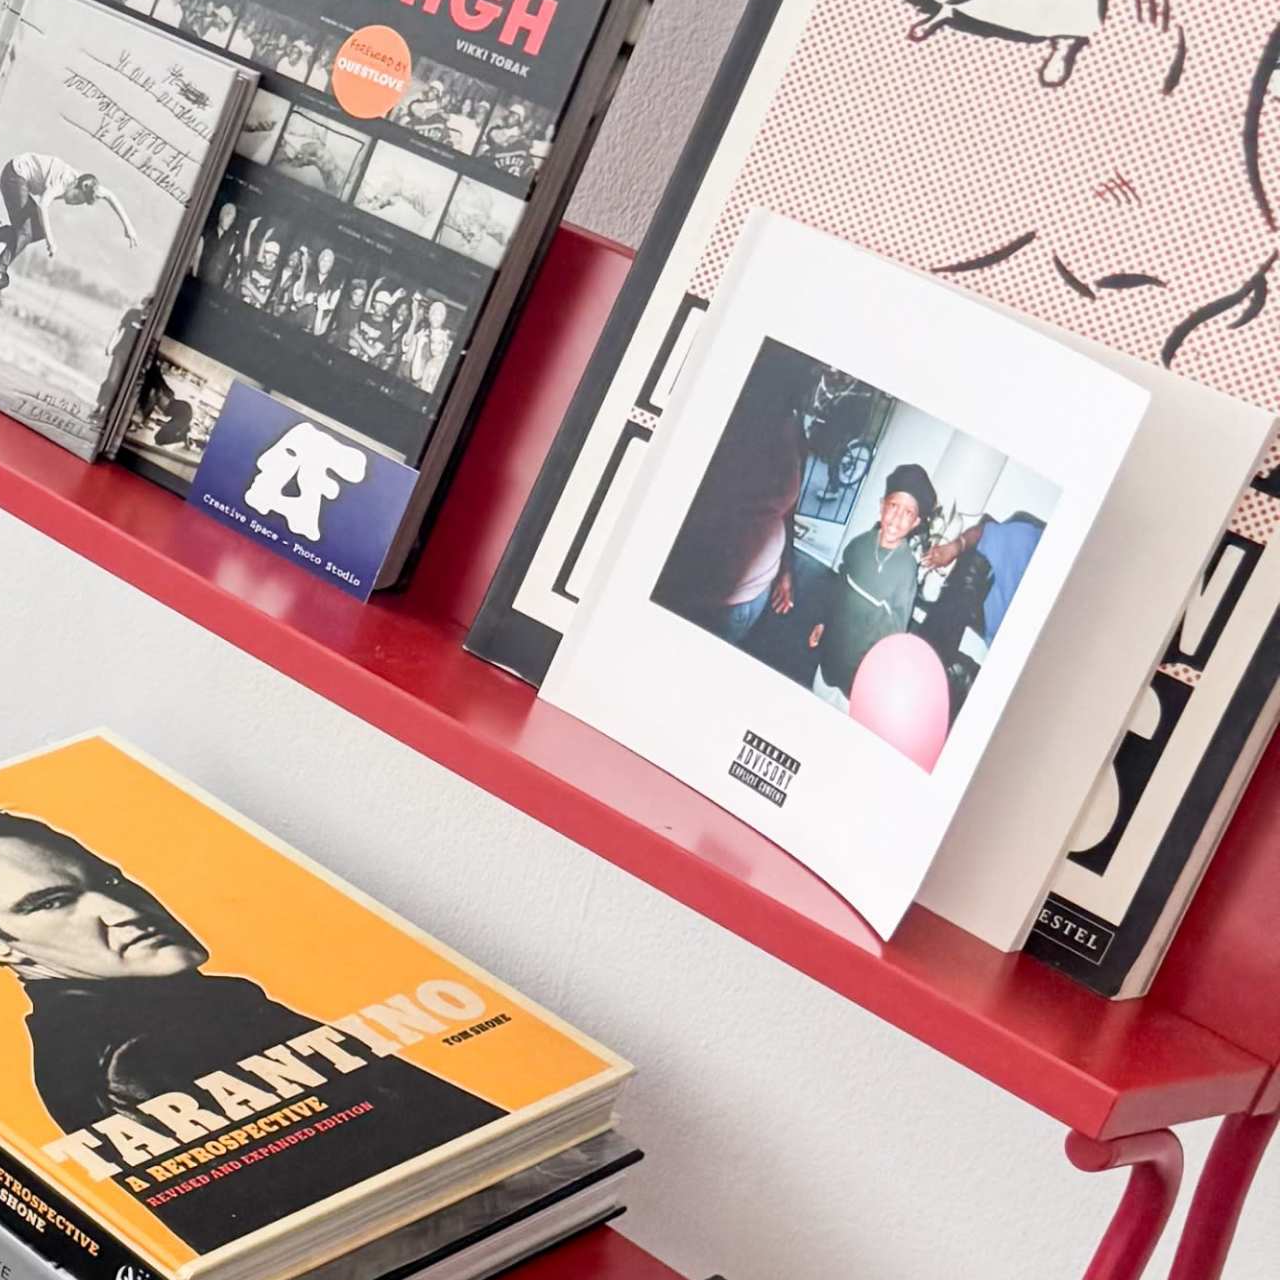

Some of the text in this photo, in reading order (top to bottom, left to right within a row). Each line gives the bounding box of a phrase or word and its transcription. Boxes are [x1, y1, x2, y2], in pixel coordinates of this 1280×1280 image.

[350, 38, 394, 68] FOREWORD
[456, 38, 531, 78] VIKKI TOBAK
[336, 56, 406, 93] QUESTLOVE
[203, 494, 247, 523] Creative
[249, 520, 279, 541] Space
[292, 543, 322, 565] Photo
[325, 561, 361, 587] Studio
[737, 744, 793, 791] ADVISORY
[745, 732, 798, 773] PARENTAL
[1038, 908, 1098, 950] ESTEL
[441, 1012, 513, 1048] TOM SHONE
[40, 978, 486, 1183] TARANTINO
[124, 1096, 329, 1193] A RETROSPECTIVE
[146, 1100, 375, 1207] REVISED AND EXPANDED EDITION
